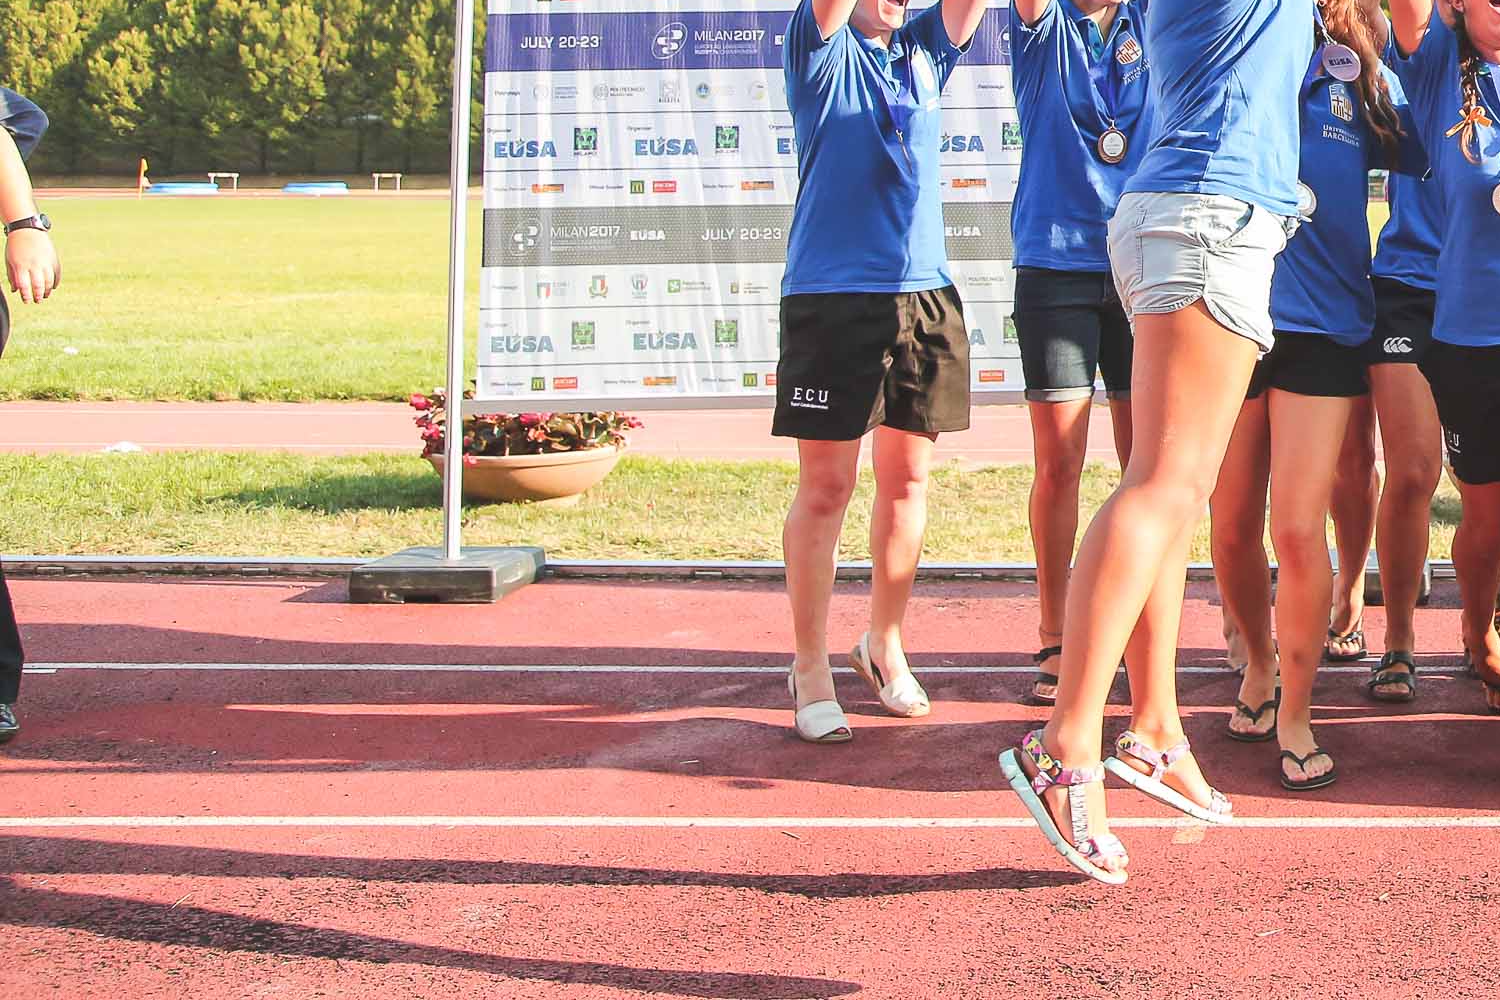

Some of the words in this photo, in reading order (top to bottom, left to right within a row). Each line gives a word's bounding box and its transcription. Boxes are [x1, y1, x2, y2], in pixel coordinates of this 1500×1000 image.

[520, 36, 554, 49] JULY
[559, 36, 600, 49] 20-23
[694, 29, 765, 42] MILAN2017
[494, 139, 557, 158] EUSA
[634, 138, 699, 157] EUSA
[551, 225, 622, 239] MILAN2017
[630, 230, 666, 241] EUSA
[701, 229, 736, 241] JULY
[740, 228, 782, 240] 20-23
[490, 334, 554, 353] EUSA
[633, 332, 697, 351] EUSA
[792, 386, 829, 404] ECU
